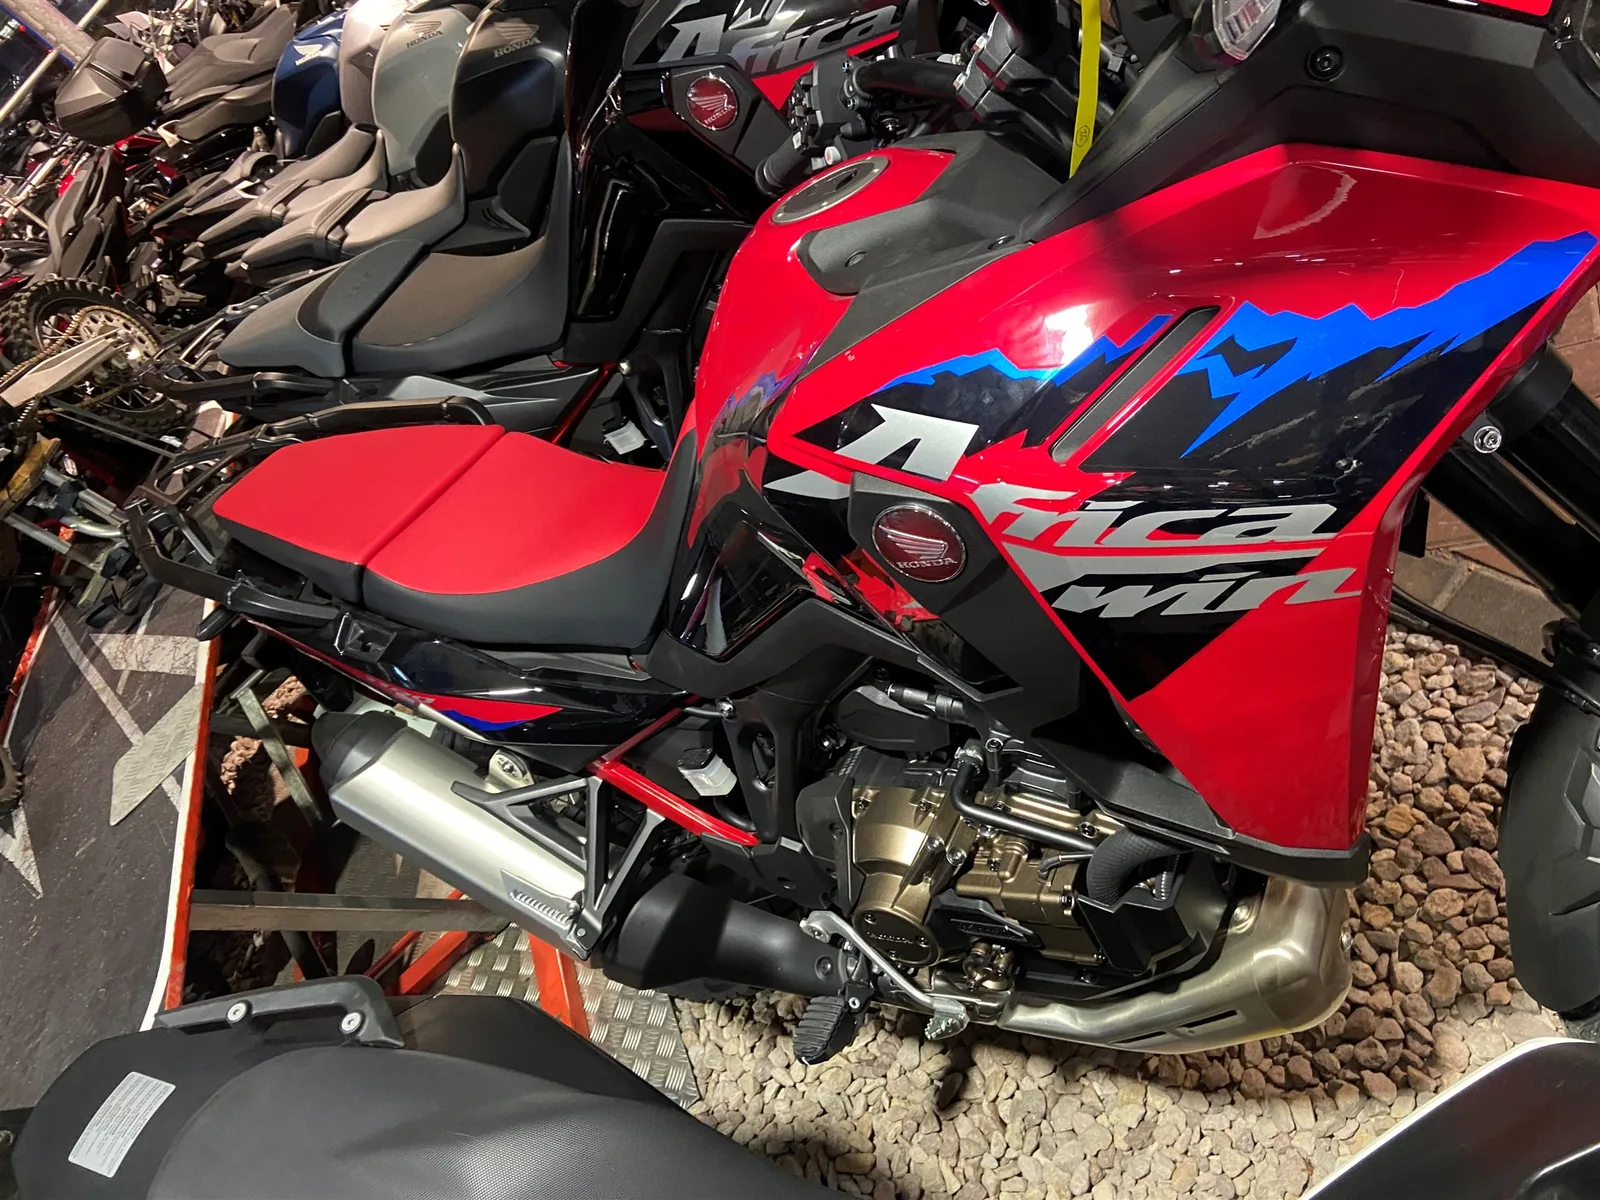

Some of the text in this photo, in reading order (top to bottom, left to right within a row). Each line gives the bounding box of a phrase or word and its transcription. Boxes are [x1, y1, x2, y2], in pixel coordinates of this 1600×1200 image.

[406, 29, 444, 49] HONDA
[493, 37, 541, 59] HONDA
[658, 5, 902, 76] Africa
[704, 104, 736, 125] HONDA
[764, 403, 1338, 548] Africa
[896, 557, 958, 569] HONDA
[1001, 541, 1363, 618] Twin
